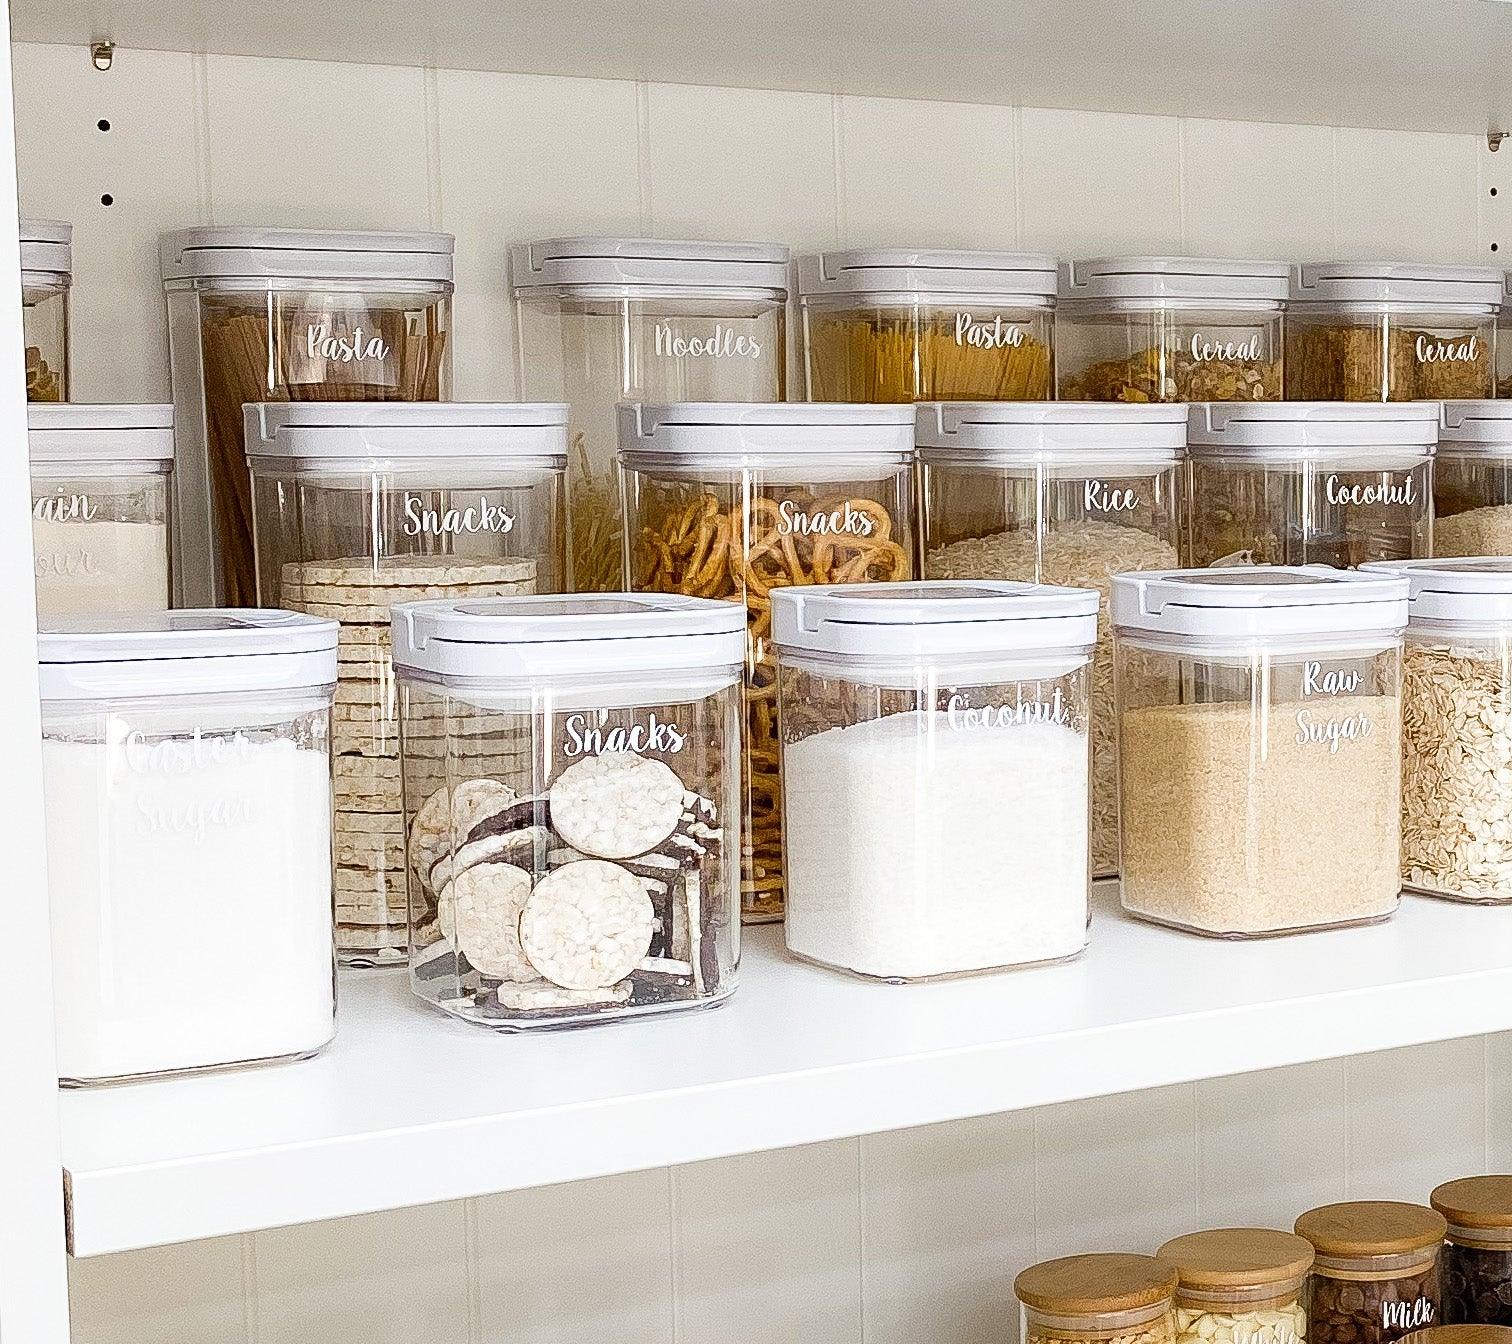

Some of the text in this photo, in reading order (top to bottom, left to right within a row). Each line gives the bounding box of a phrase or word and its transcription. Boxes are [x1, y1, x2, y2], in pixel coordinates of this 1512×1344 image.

[305, 323, 390, 364] Pasta
[653, 319, 764, 360] Noodles
[953, 311, 1025, 351] Pasta
[1189, 331, 1263, 364] Cereal
[1415, 333, 1481, 365] Cereal
[34, 487, 98, 524] ain
[1083, 478, 1140, 513] Rice
[1325, 469, 1418, 507] Coconut
[402, 493, 517, 538] Snacks
[775, 499, 876, 538] Snacks
[34, 544, 97, 578] our
[1302, 660, 1365, 696] Raw
[946, 687, 1070, 733] Coconut
[563, 711, 687, 757] Snacks
[1295, 709, 1373, 756] Sugar
[1382, 1296, 1436, 1331] Milk
